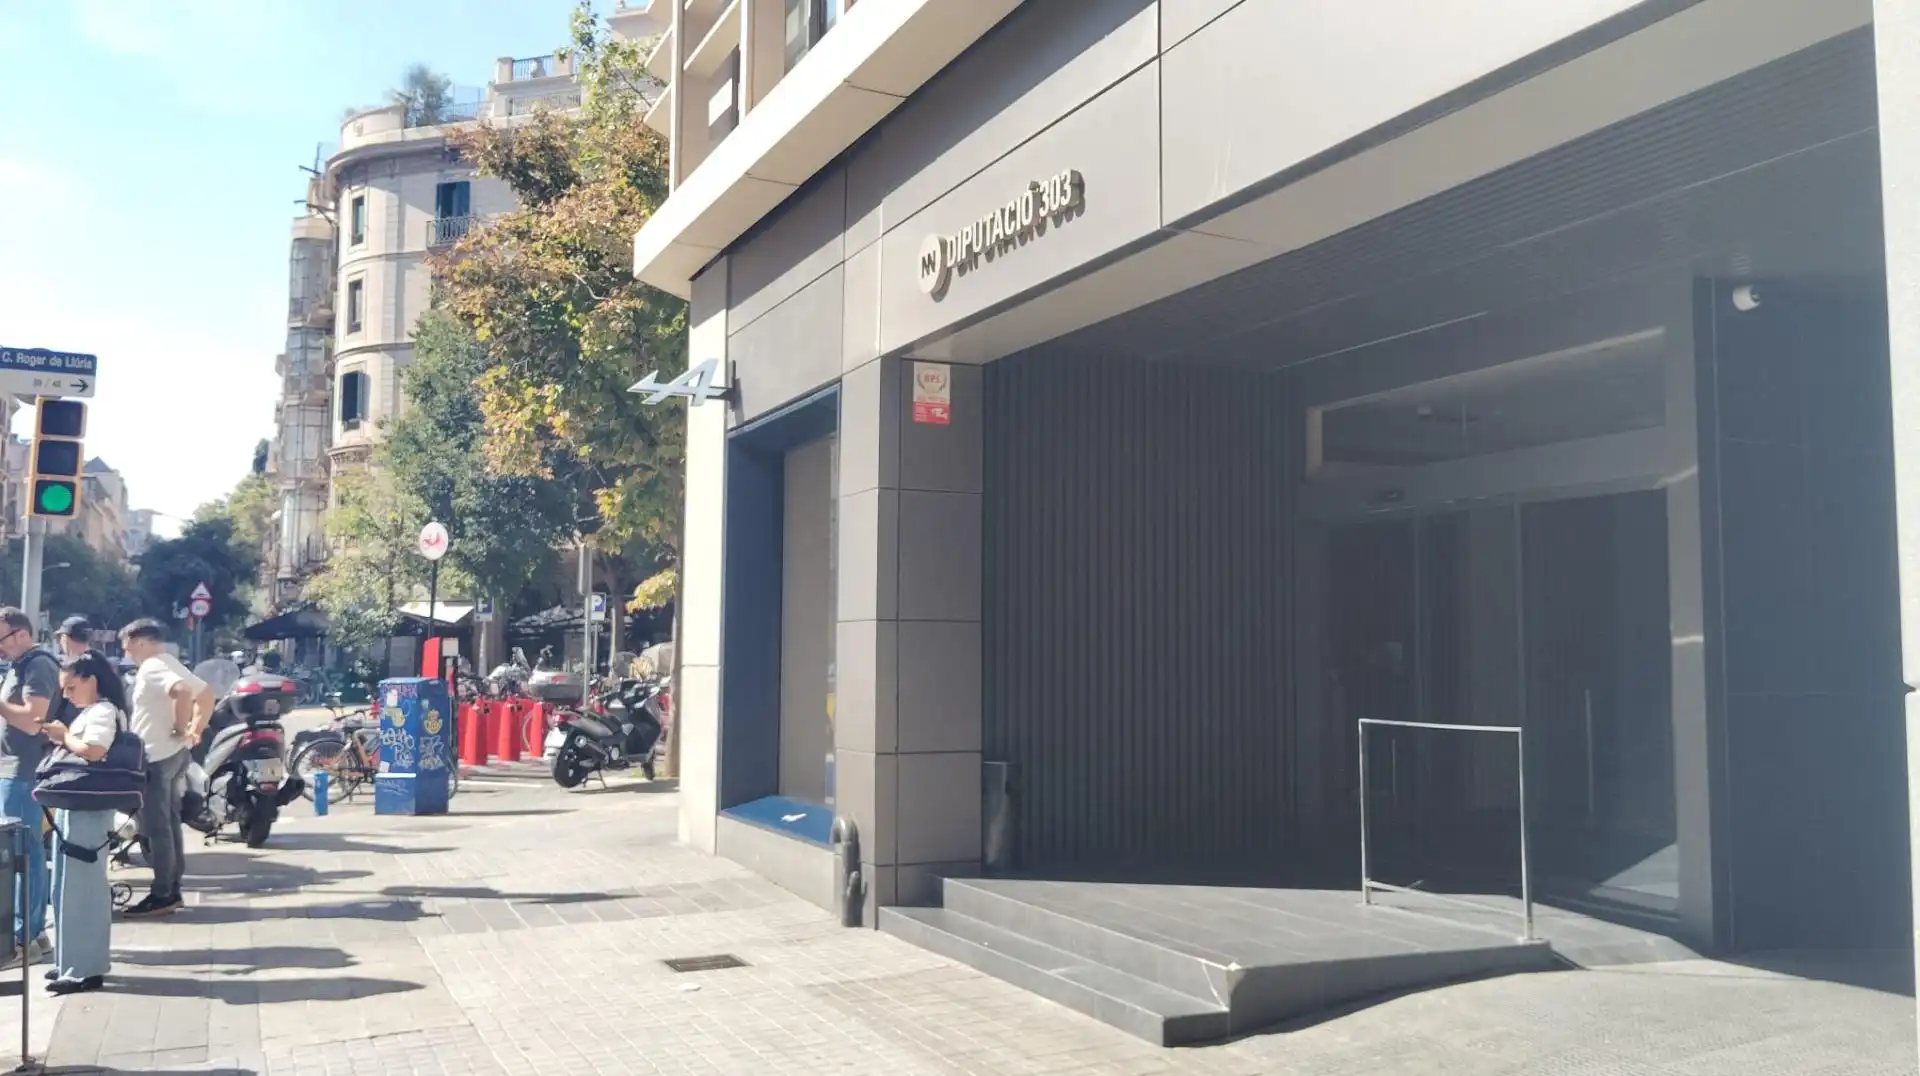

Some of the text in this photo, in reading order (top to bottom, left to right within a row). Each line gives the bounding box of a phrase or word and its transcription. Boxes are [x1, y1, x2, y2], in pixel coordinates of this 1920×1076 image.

[946, 168, 1073, 268] DIPUTACIÓ 303
[2, 351, 13, 364] C.
[16, 352, 47, 367] Roger
[49, 355, 62, 367] de
